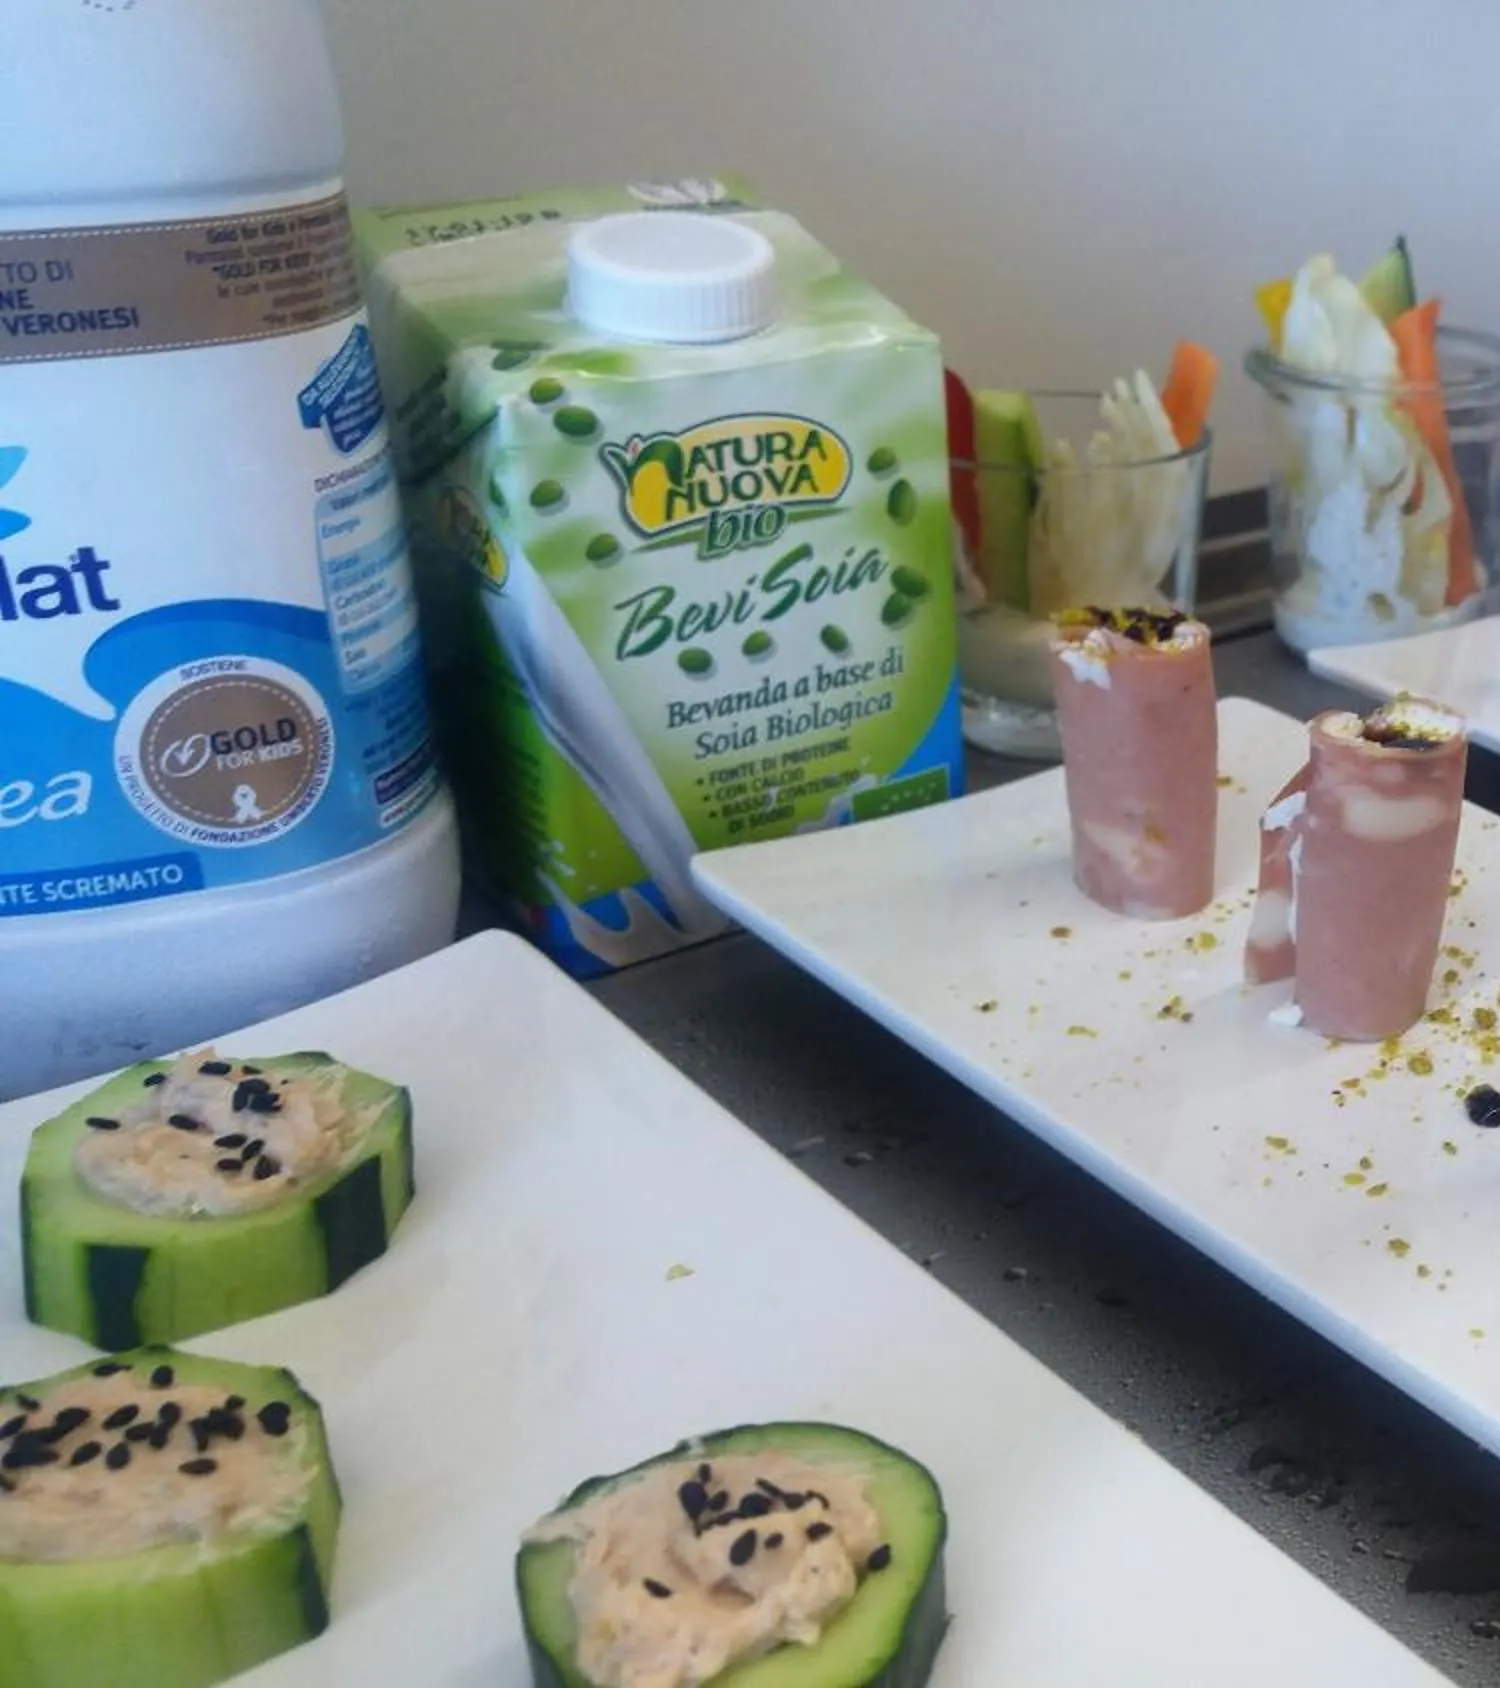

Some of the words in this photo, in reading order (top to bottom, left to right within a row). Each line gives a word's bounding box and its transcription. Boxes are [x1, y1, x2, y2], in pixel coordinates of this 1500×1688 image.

[45, 261, 74, 282] DI
[2, 306, 139, 337] VERONESI
[603, 429, 828, 498] NATURA
[665, 463, 820, 523] NUOVA
[705, 503, 788, 554] bio
[666, 676, 788, 729] Bevanda
[794, 676, 811, 693] a
[815, 657, 876, 694] base
[879, 646, 905, 676] di
[210, 717, 297, 755] GOLD
[693, 722, 758, 760] Soia
[766, 690, 894, 743] Biologica
[215, 748, 256, 772] FOR
[259, 738, 304, 762] KIDS
[761, 755, 778, 771] DI
[41, 863, 184, 901] SCREMATO
